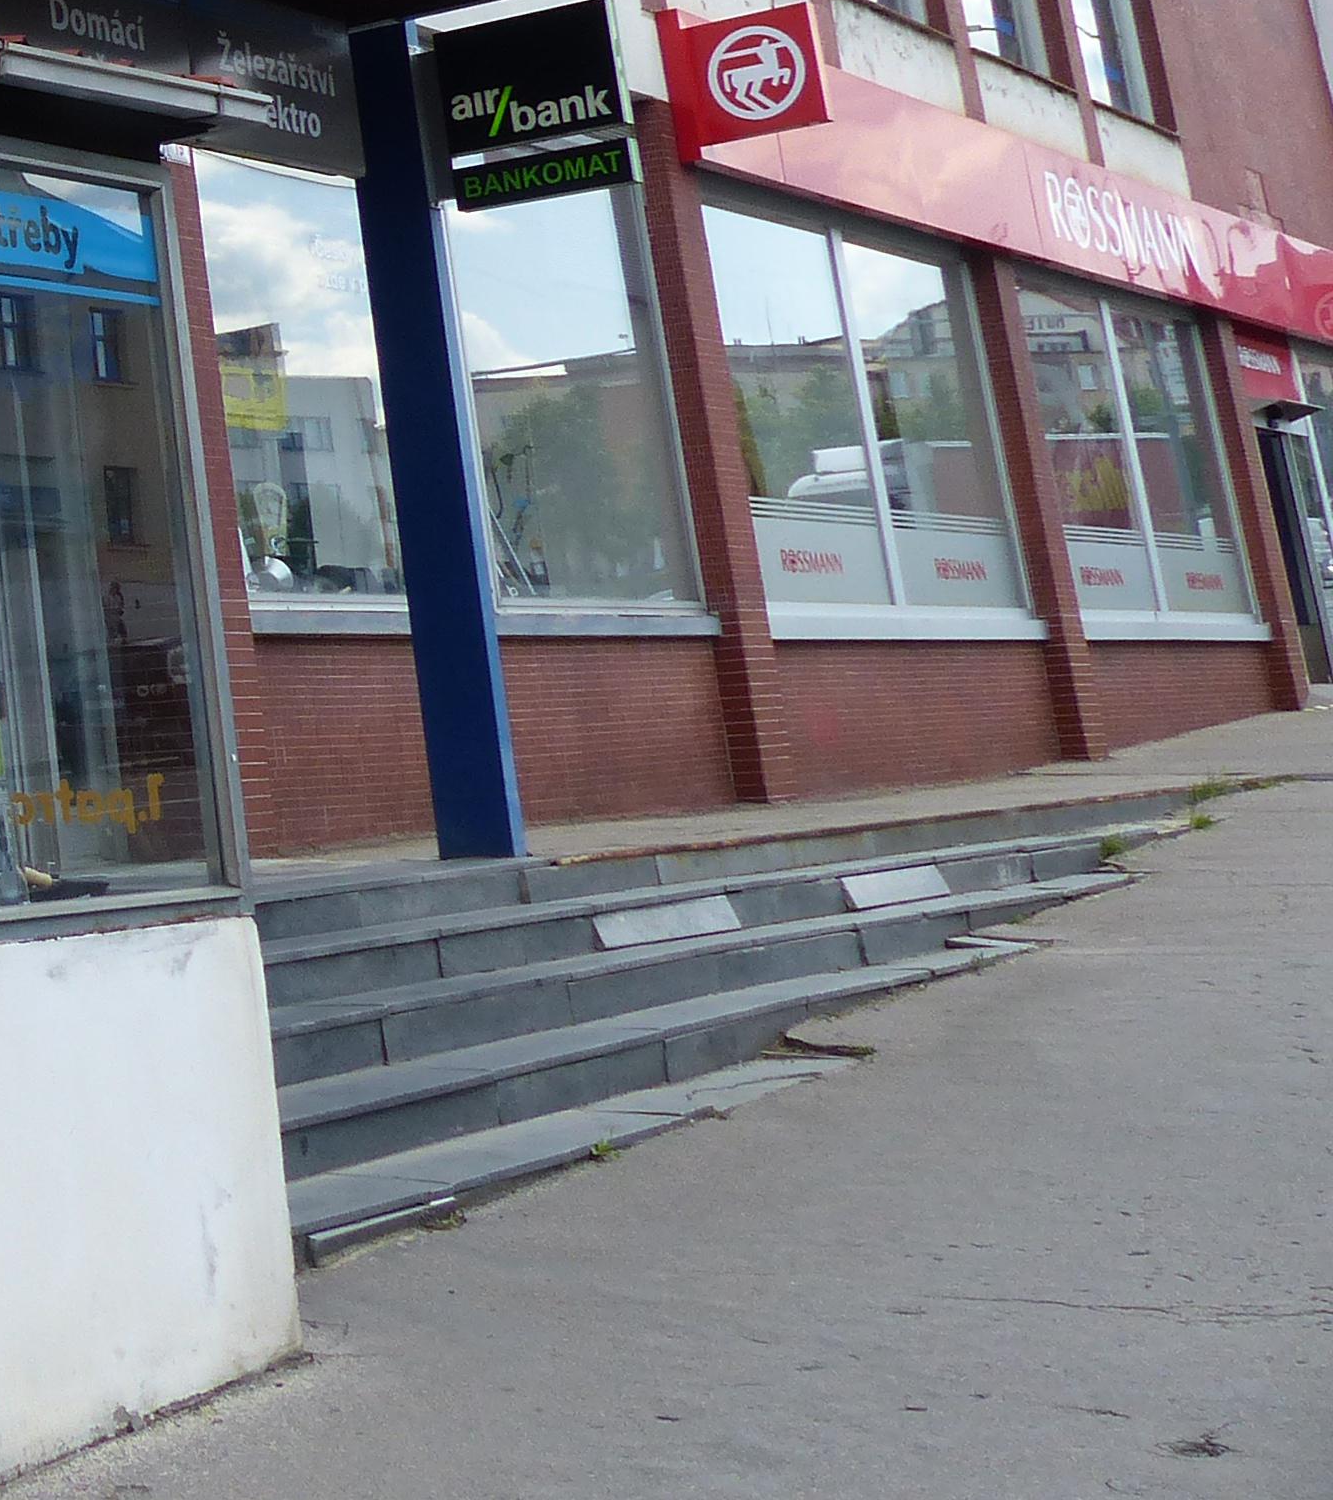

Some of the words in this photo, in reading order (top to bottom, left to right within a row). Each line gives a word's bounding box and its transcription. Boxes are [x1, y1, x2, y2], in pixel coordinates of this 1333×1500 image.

[217, 29, 336, 97] Železářství
[266, 95, 322, 139] ektro
[463, 150, 622, 199] BANKOMAT
[1044, 170, 1203, 278] ROSSMANN
[780, 549, 845, 574] ROSSMANN
[934, 557, 989, 581] ROSSMANN
